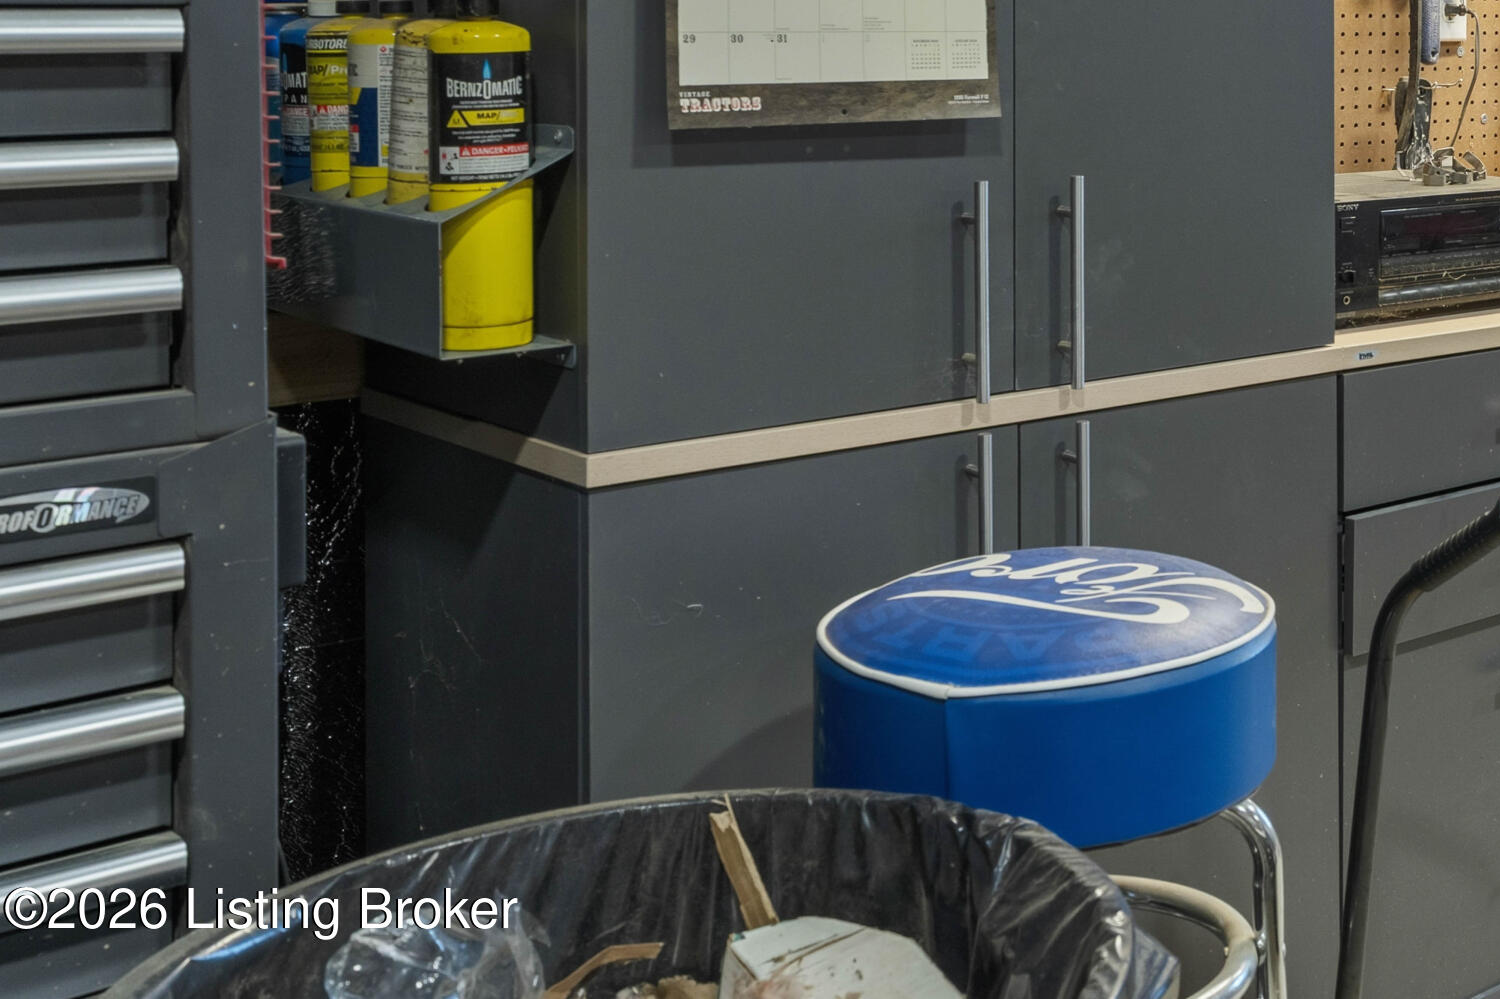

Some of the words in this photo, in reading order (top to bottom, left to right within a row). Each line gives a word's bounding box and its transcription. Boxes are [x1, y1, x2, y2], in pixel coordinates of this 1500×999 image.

[682, 34, 696, 44] 29
[730, 34, 744, 43] 30
[776, 34, 788, 43] 31
[446, 75, 523, 100] BERNZOMATIC
[680, 97, 762, 113] TRACTORS
[1337, 203, 1359, 212] SONY
[0, 494, 140, 534] ROFORMANCE
[887, 552, 1266, 625] Ford
